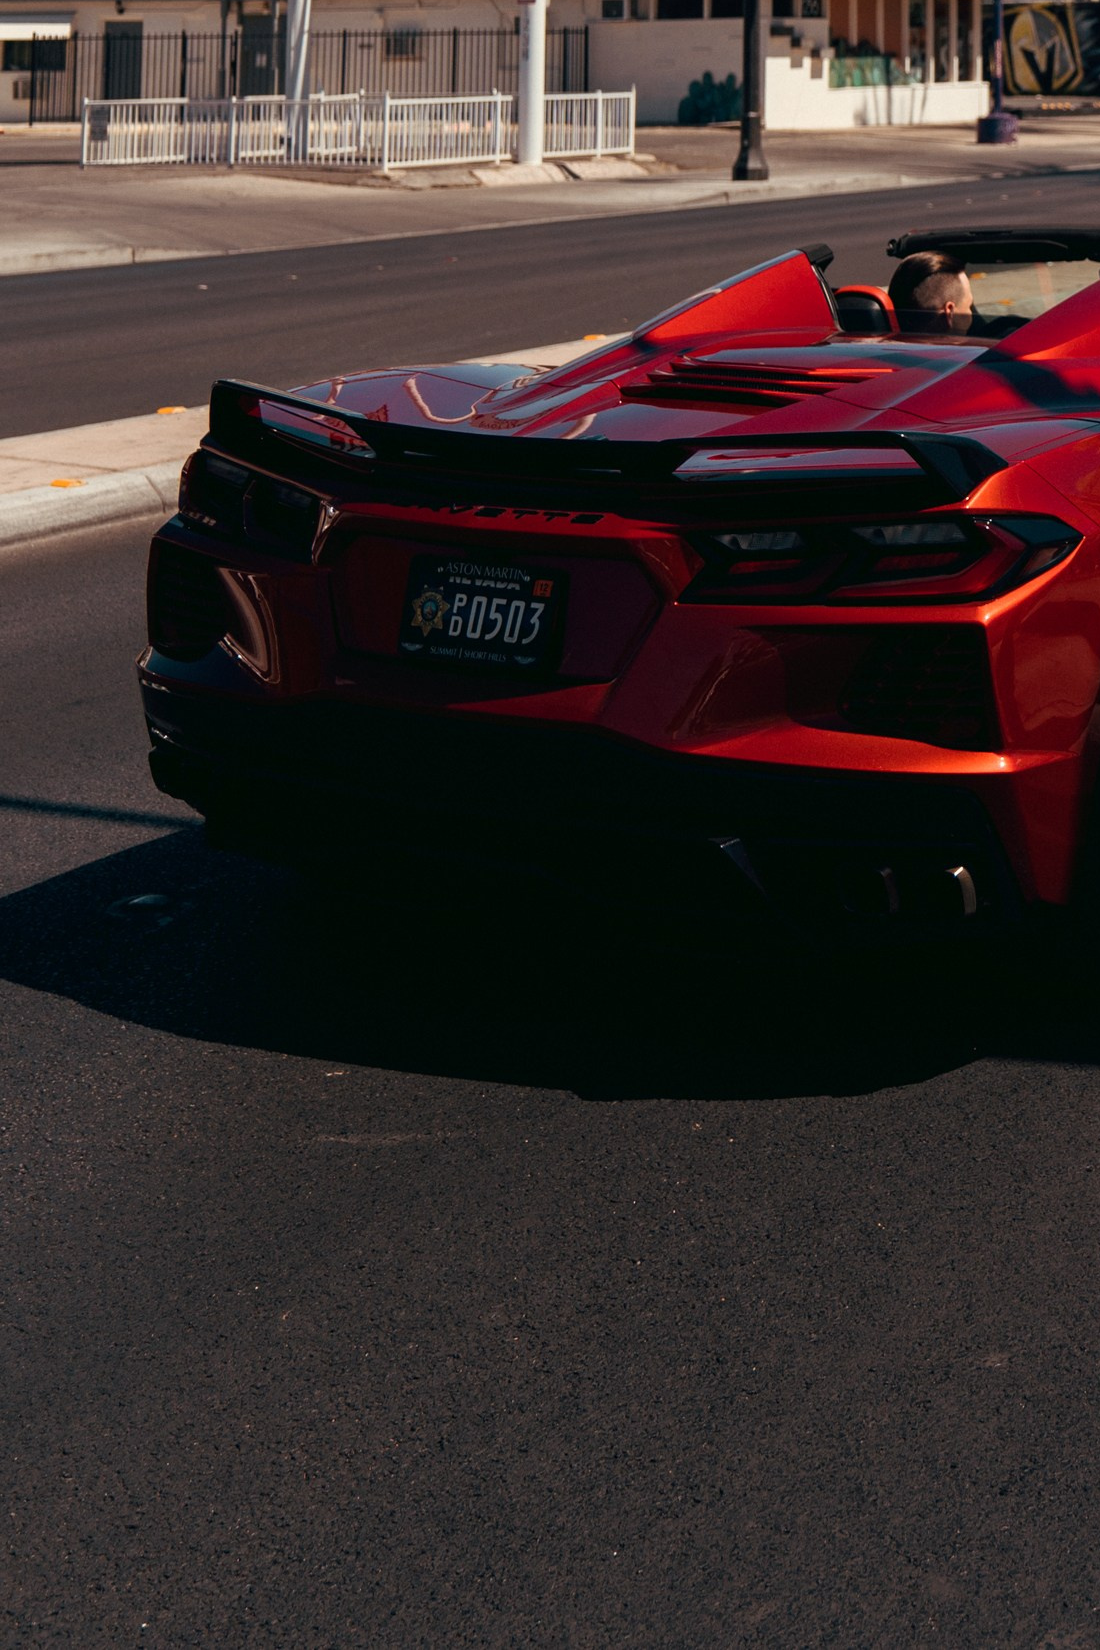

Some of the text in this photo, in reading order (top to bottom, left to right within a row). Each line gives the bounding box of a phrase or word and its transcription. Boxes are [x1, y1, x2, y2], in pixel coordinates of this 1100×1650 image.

[446, 562, 527, 581] ASTON MARTIN
[430, 645, 507, 663] SUMMIT SHORT HILLS
